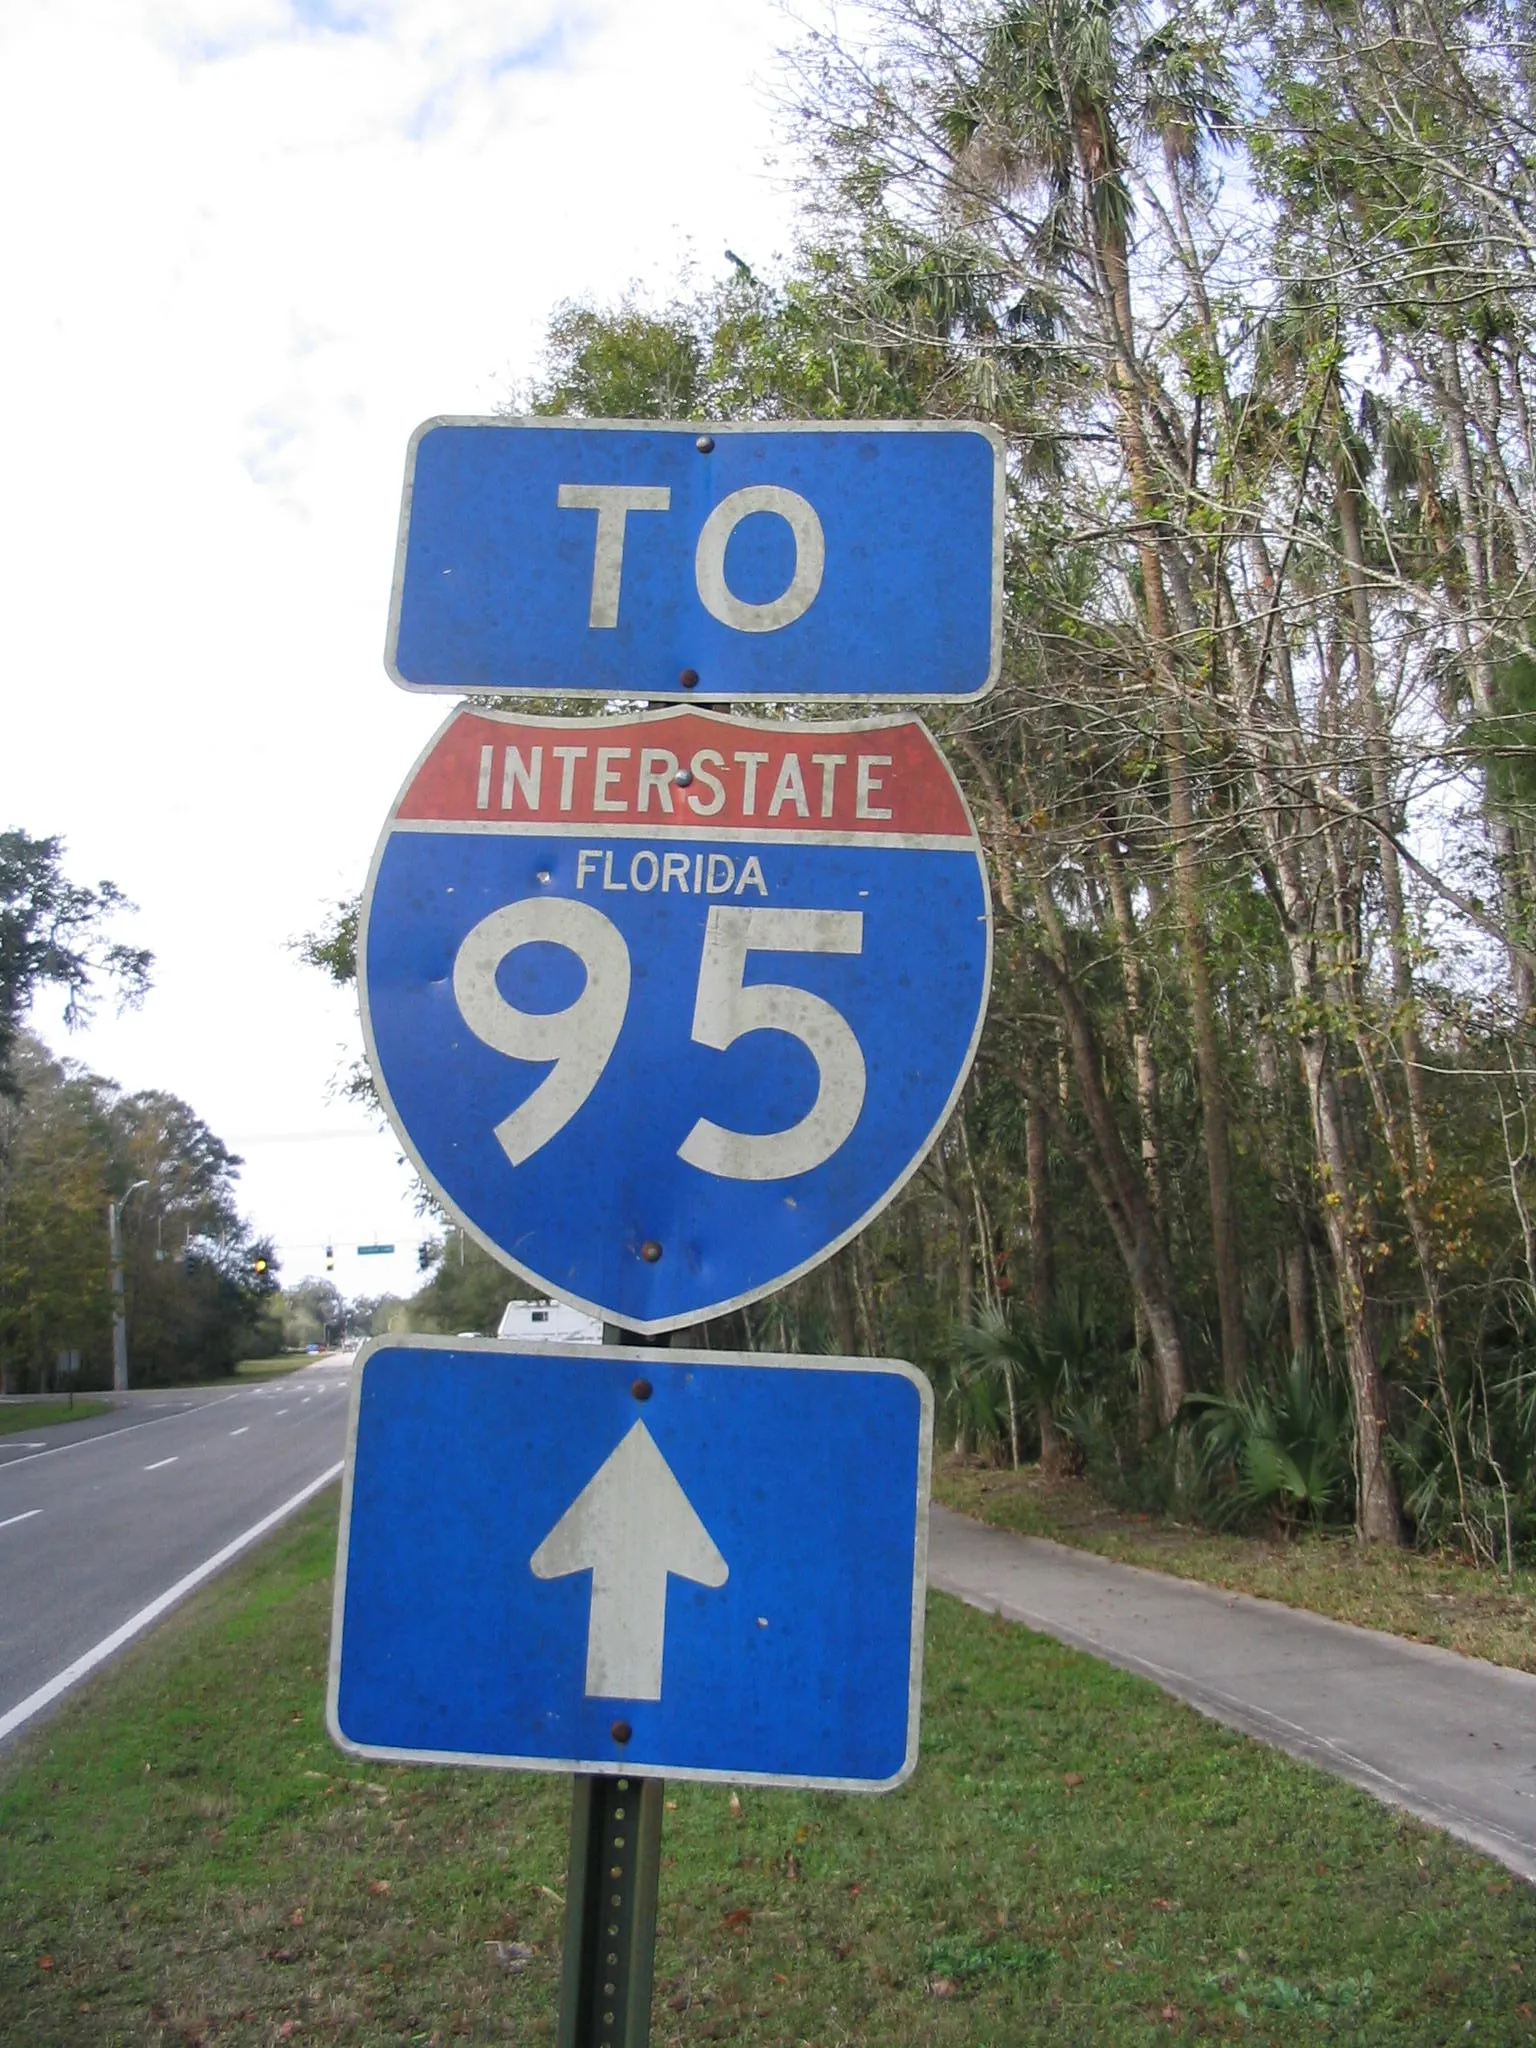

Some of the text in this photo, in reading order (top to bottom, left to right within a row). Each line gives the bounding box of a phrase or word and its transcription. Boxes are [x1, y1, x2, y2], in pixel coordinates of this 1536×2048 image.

[557, 483, 825, 633] TO
[476, 744, 893, 820] INTERSTATE
[576, 849, 769, 896] FLORIDA
[453, 896, 867, 1180] 95
